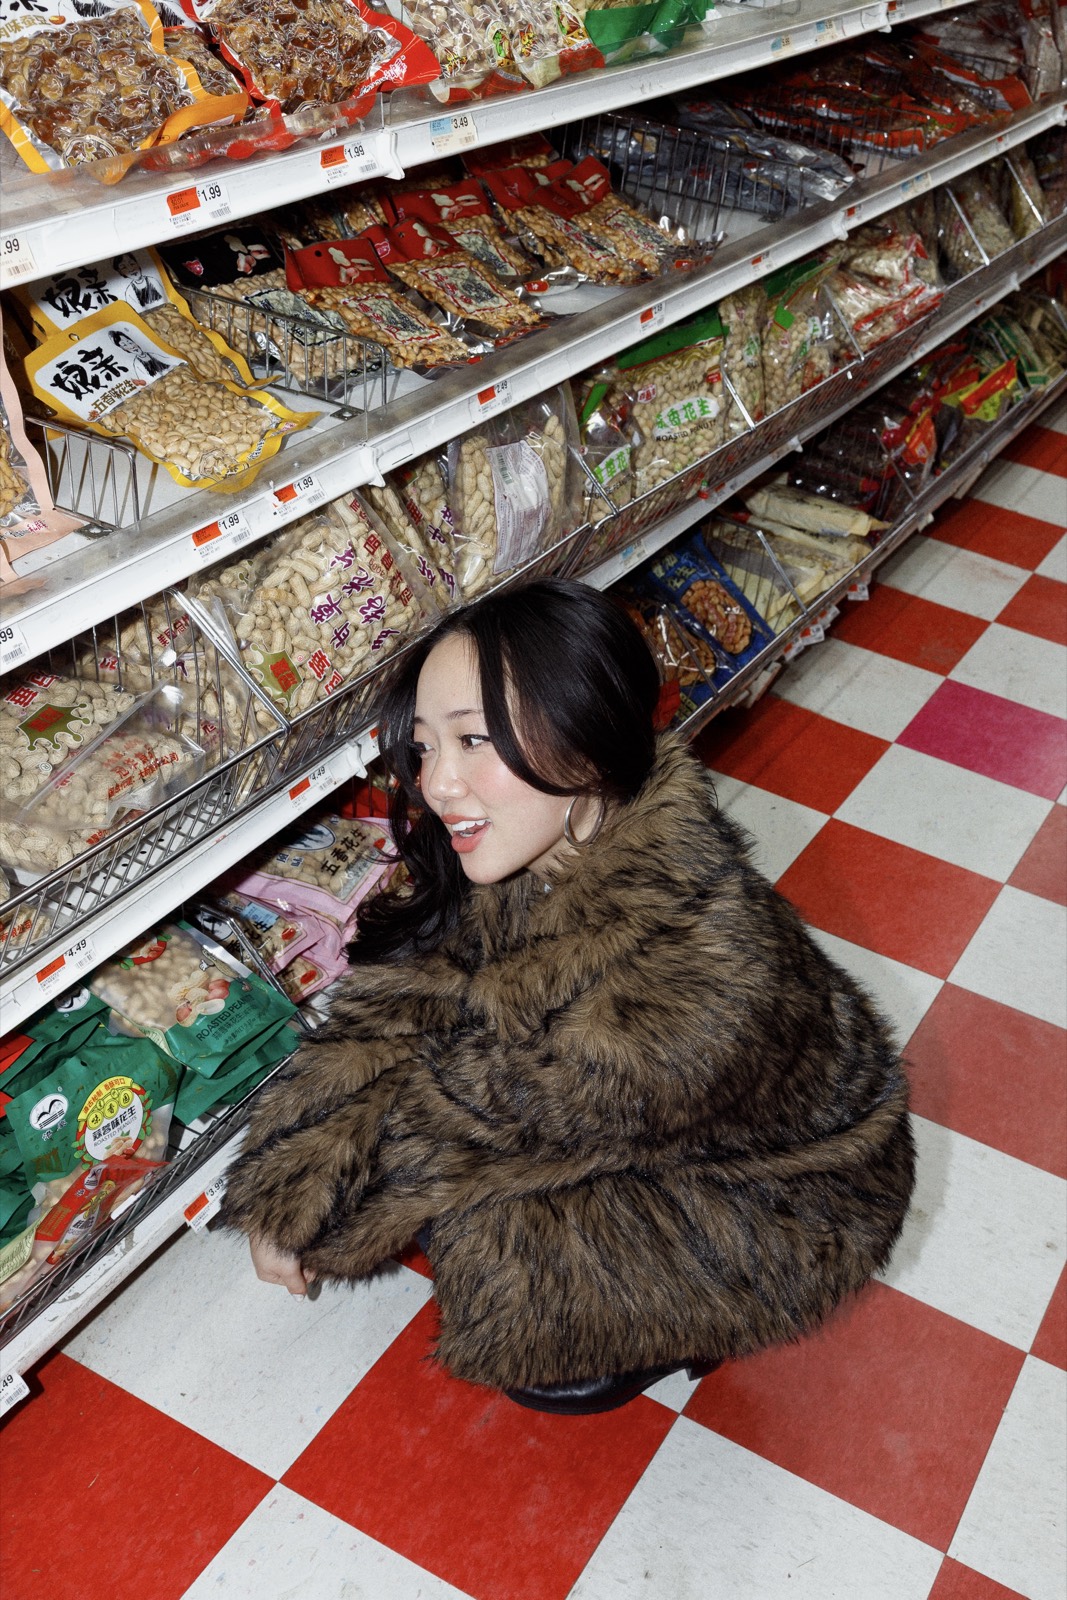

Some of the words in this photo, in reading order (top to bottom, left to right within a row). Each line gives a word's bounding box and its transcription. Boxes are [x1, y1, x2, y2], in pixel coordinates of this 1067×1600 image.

[0, 238, 19, 256] .99
[49, 346, 129, 401] 娘亲
[91, 379, 137, 413] 五香味花生
[320, 828, 367, 877] 五香花生
[196, 1012, 230, 1043] ROASTED
[94, 1125, 117, 1147] ROASTED
[116, 1114, 138, 1136] PEANUTS
